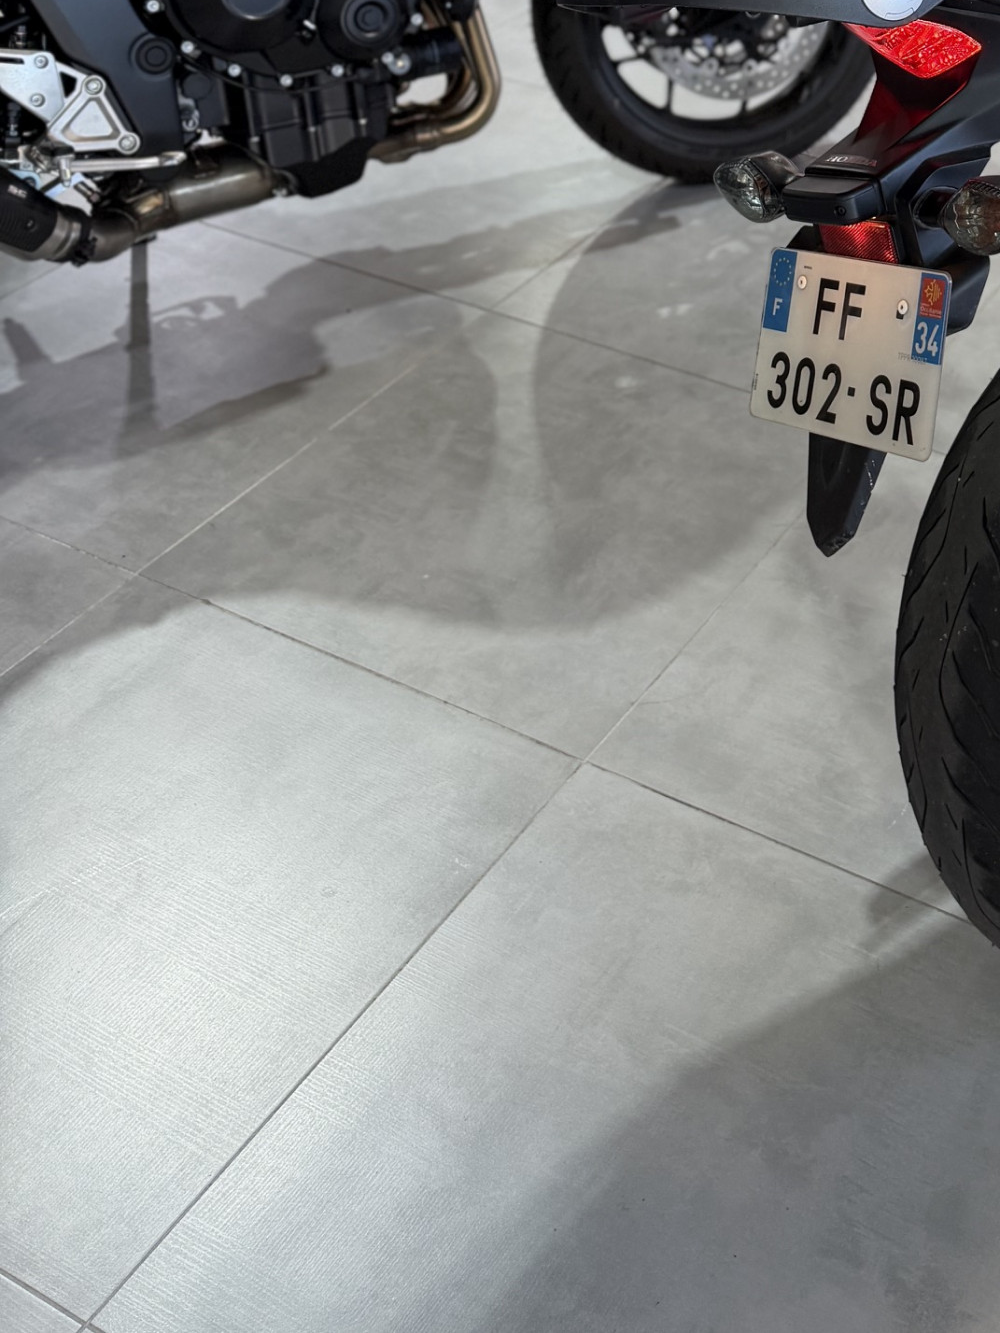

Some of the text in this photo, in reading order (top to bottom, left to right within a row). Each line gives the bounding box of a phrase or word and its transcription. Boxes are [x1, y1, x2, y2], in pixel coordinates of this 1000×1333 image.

[772, 297, 783, 316] F
[813, 278, 866, 340] FF
[915, 322, 940, 357] 34
